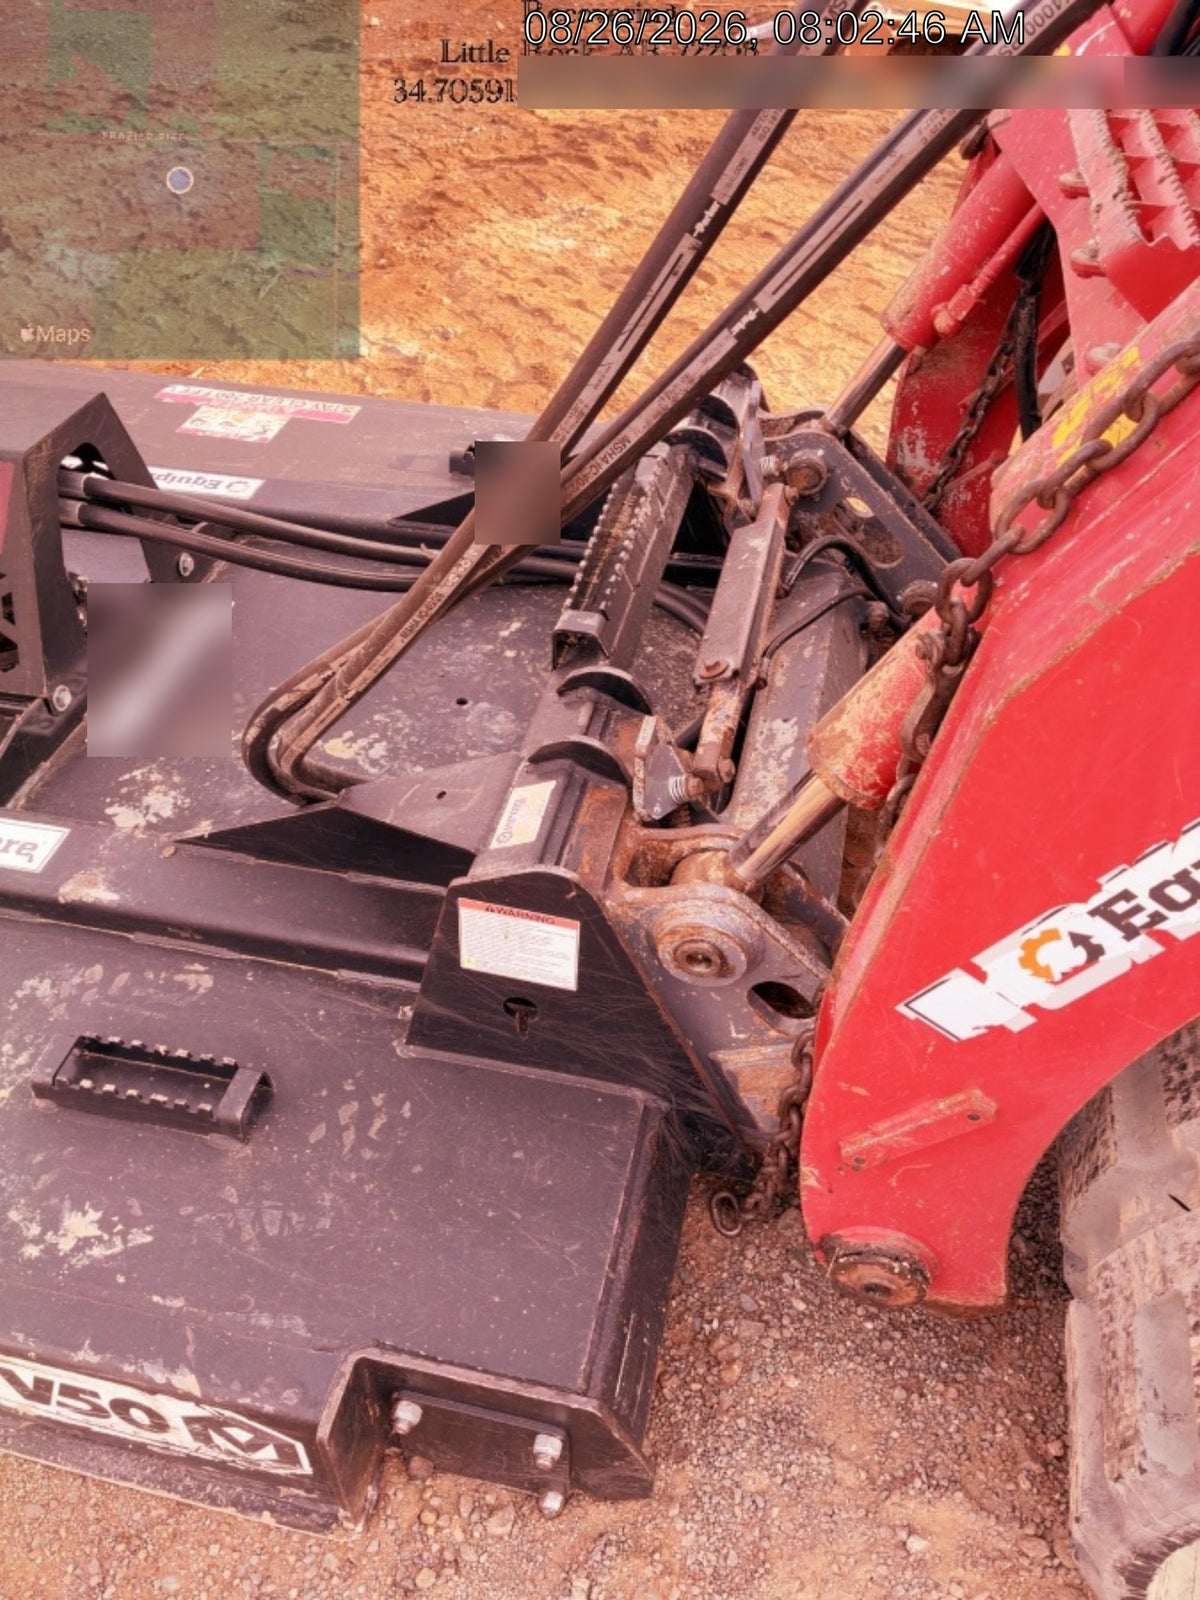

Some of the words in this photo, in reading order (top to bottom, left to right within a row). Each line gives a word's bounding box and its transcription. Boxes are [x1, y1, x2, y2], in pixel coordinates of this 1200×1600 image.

[600, 435, 632, 465] MSHA
[154, 472, 223, 491] Equip
[0, 837, 39, 863] re
[496, 905, 556, 925] WARNING
